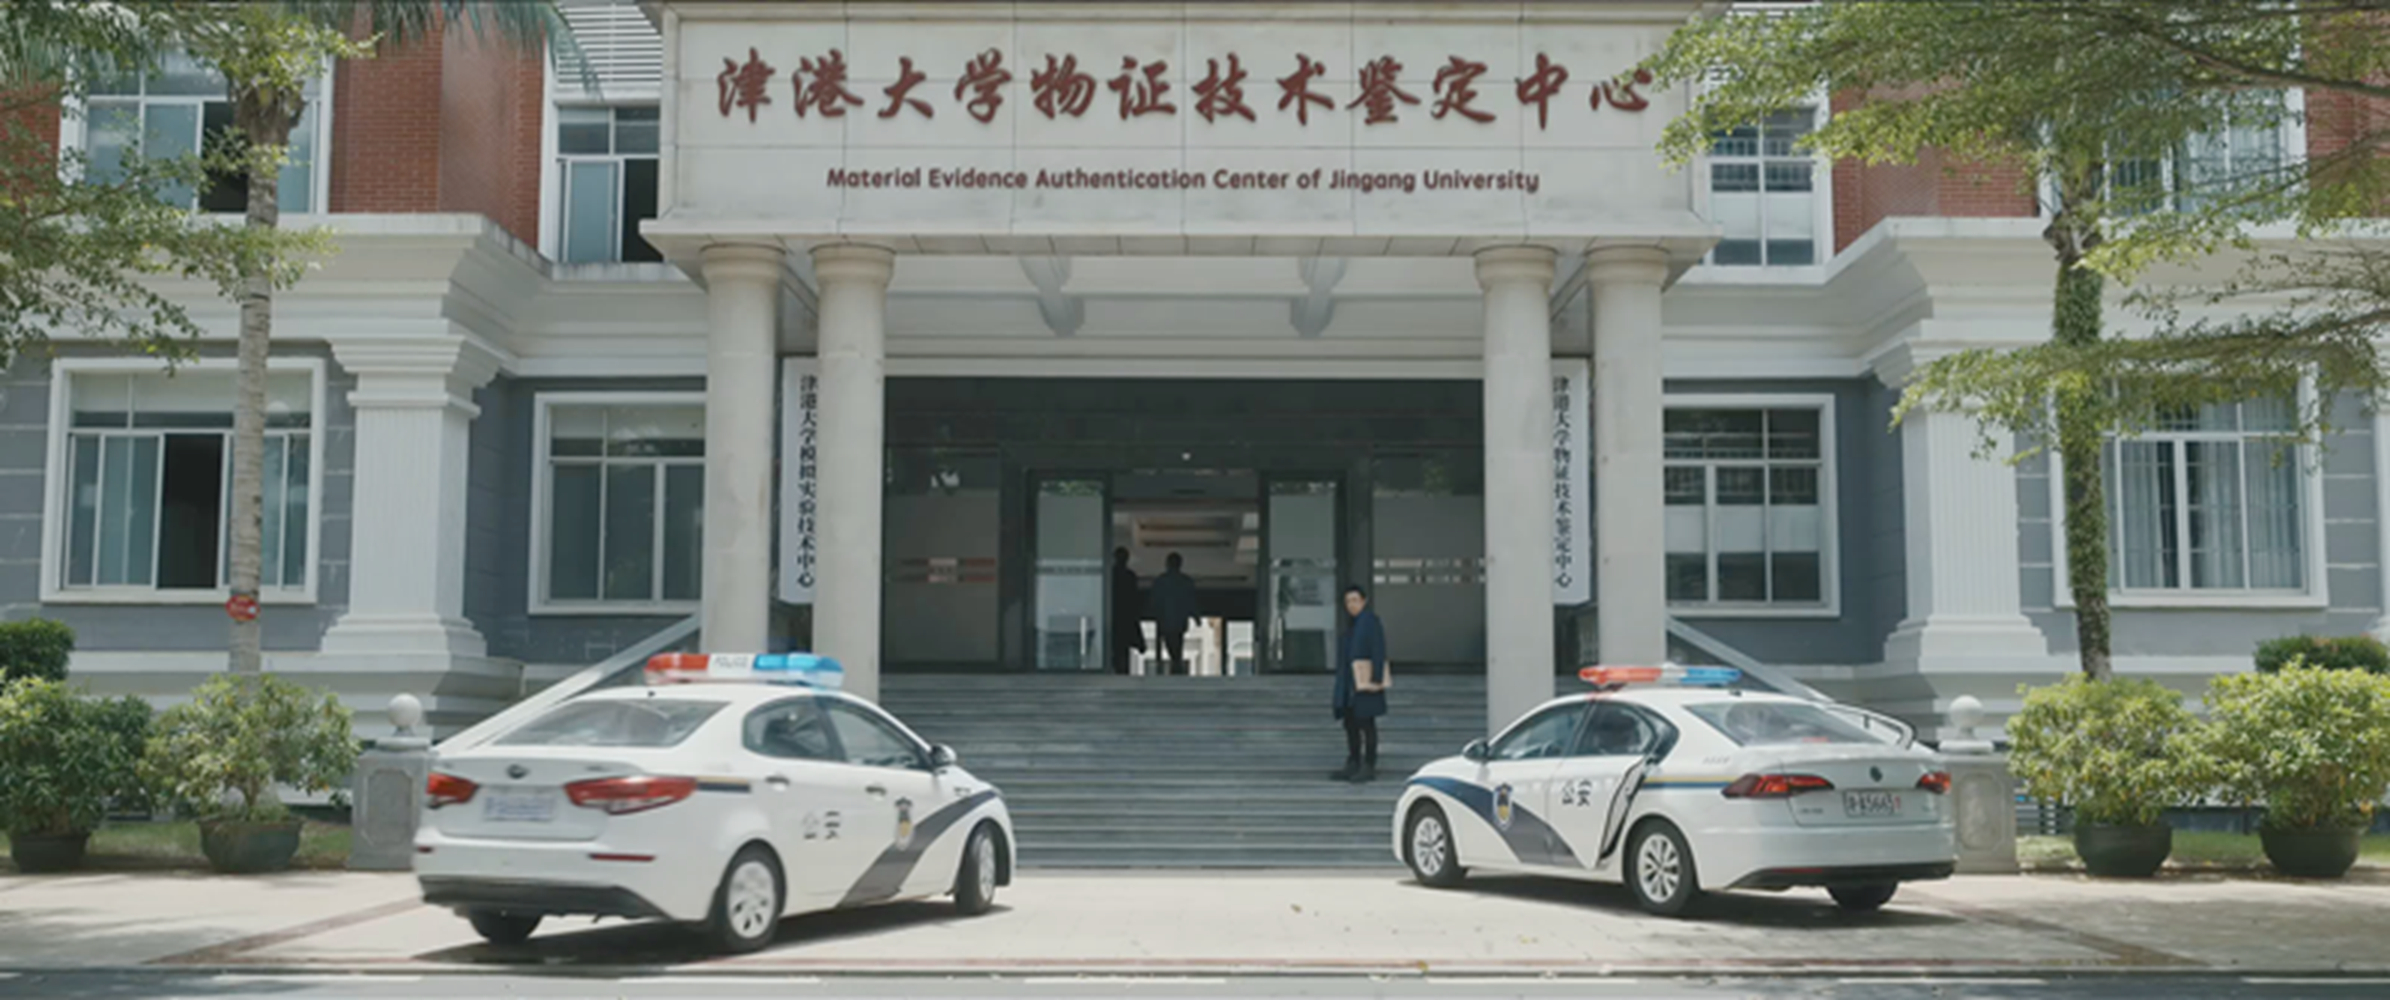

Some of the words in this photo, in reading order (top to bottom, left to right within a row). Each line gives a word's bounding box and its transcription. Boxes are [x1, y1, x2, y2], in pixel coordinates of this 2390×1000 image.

[716, 47, 1654, 130] 津港大学物证技术鉴定中心
[826, 167, 921, 189] Material
[928, 167, 1028, 189] Evidence
[1034, 167, 1206, 189] Authentication
[1212, 168, 1290, 189] Center
[1296, 168, 1322, 189] of
[1328, 168, 1417, 193] Jingang
[1422, 168, 1540, 194] University
[1561, 779, 1592, 807] 公安
